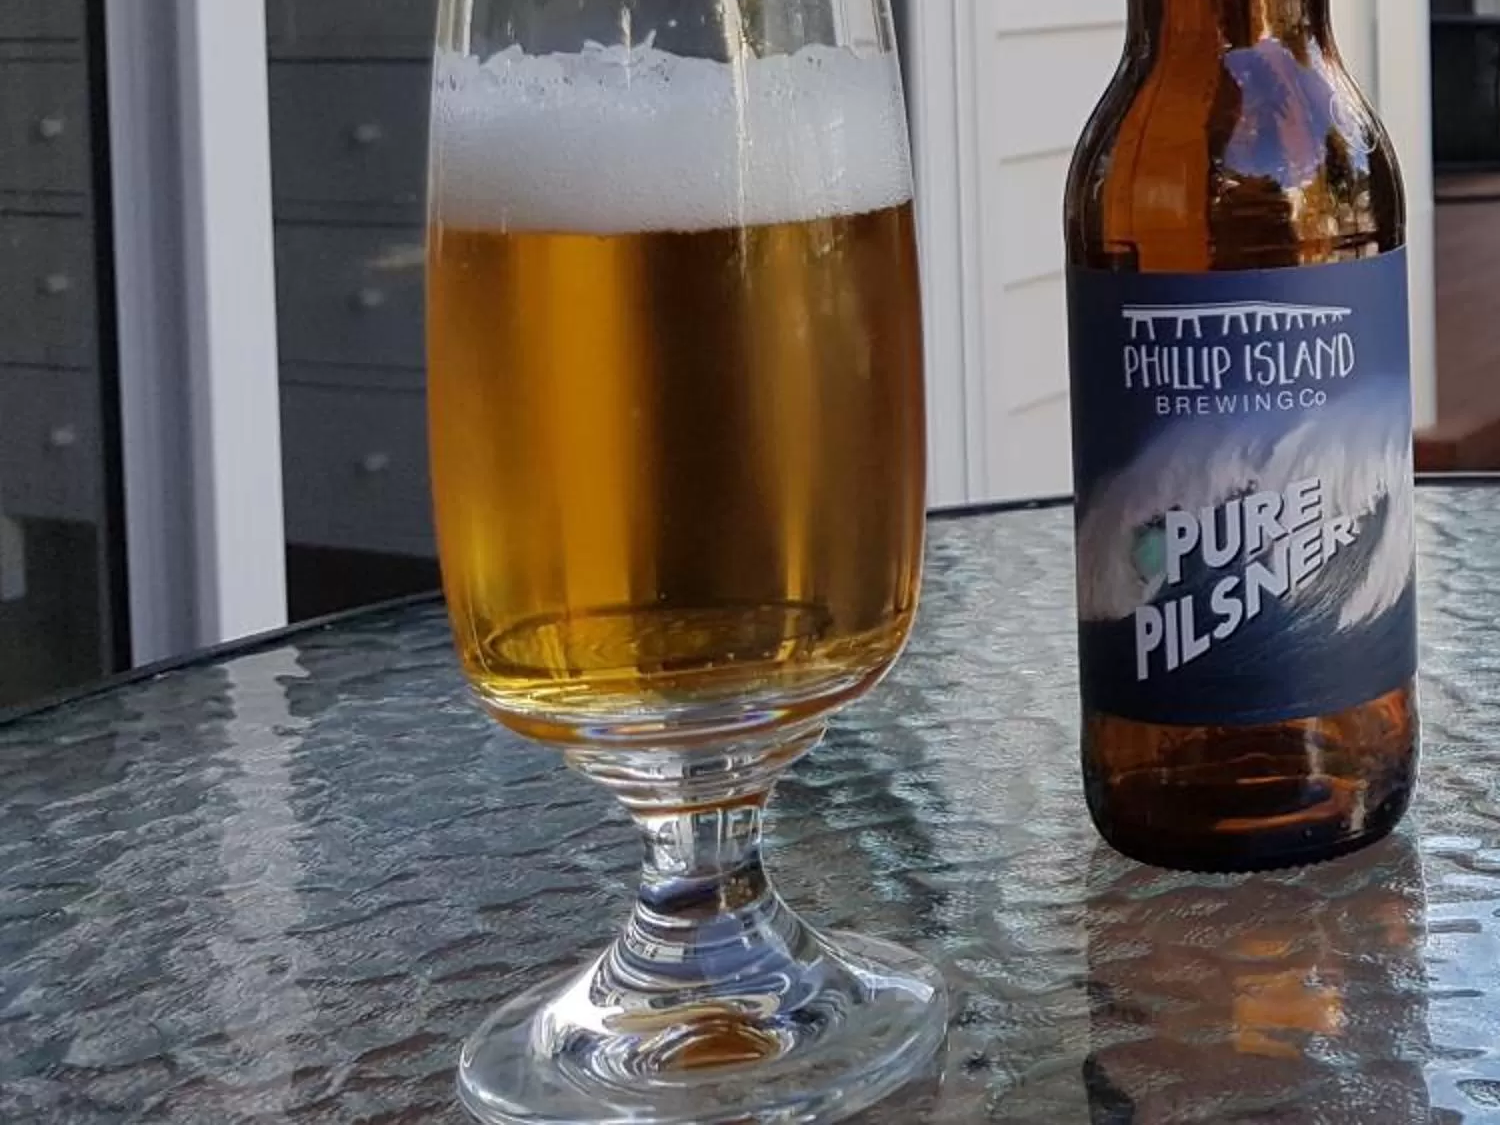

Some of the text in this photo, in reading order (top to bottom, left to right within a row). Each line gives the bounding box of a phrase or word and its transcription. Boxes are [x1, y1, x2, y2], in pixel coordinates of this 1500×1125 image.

[1123, 332, 1355, 390] PHILLIP ISLAND
[1156, 390, 1294, 415] BREWING
[1165, 476, 1322, 585] PURE
[1135, 516, 1360, 682] PILSNER
